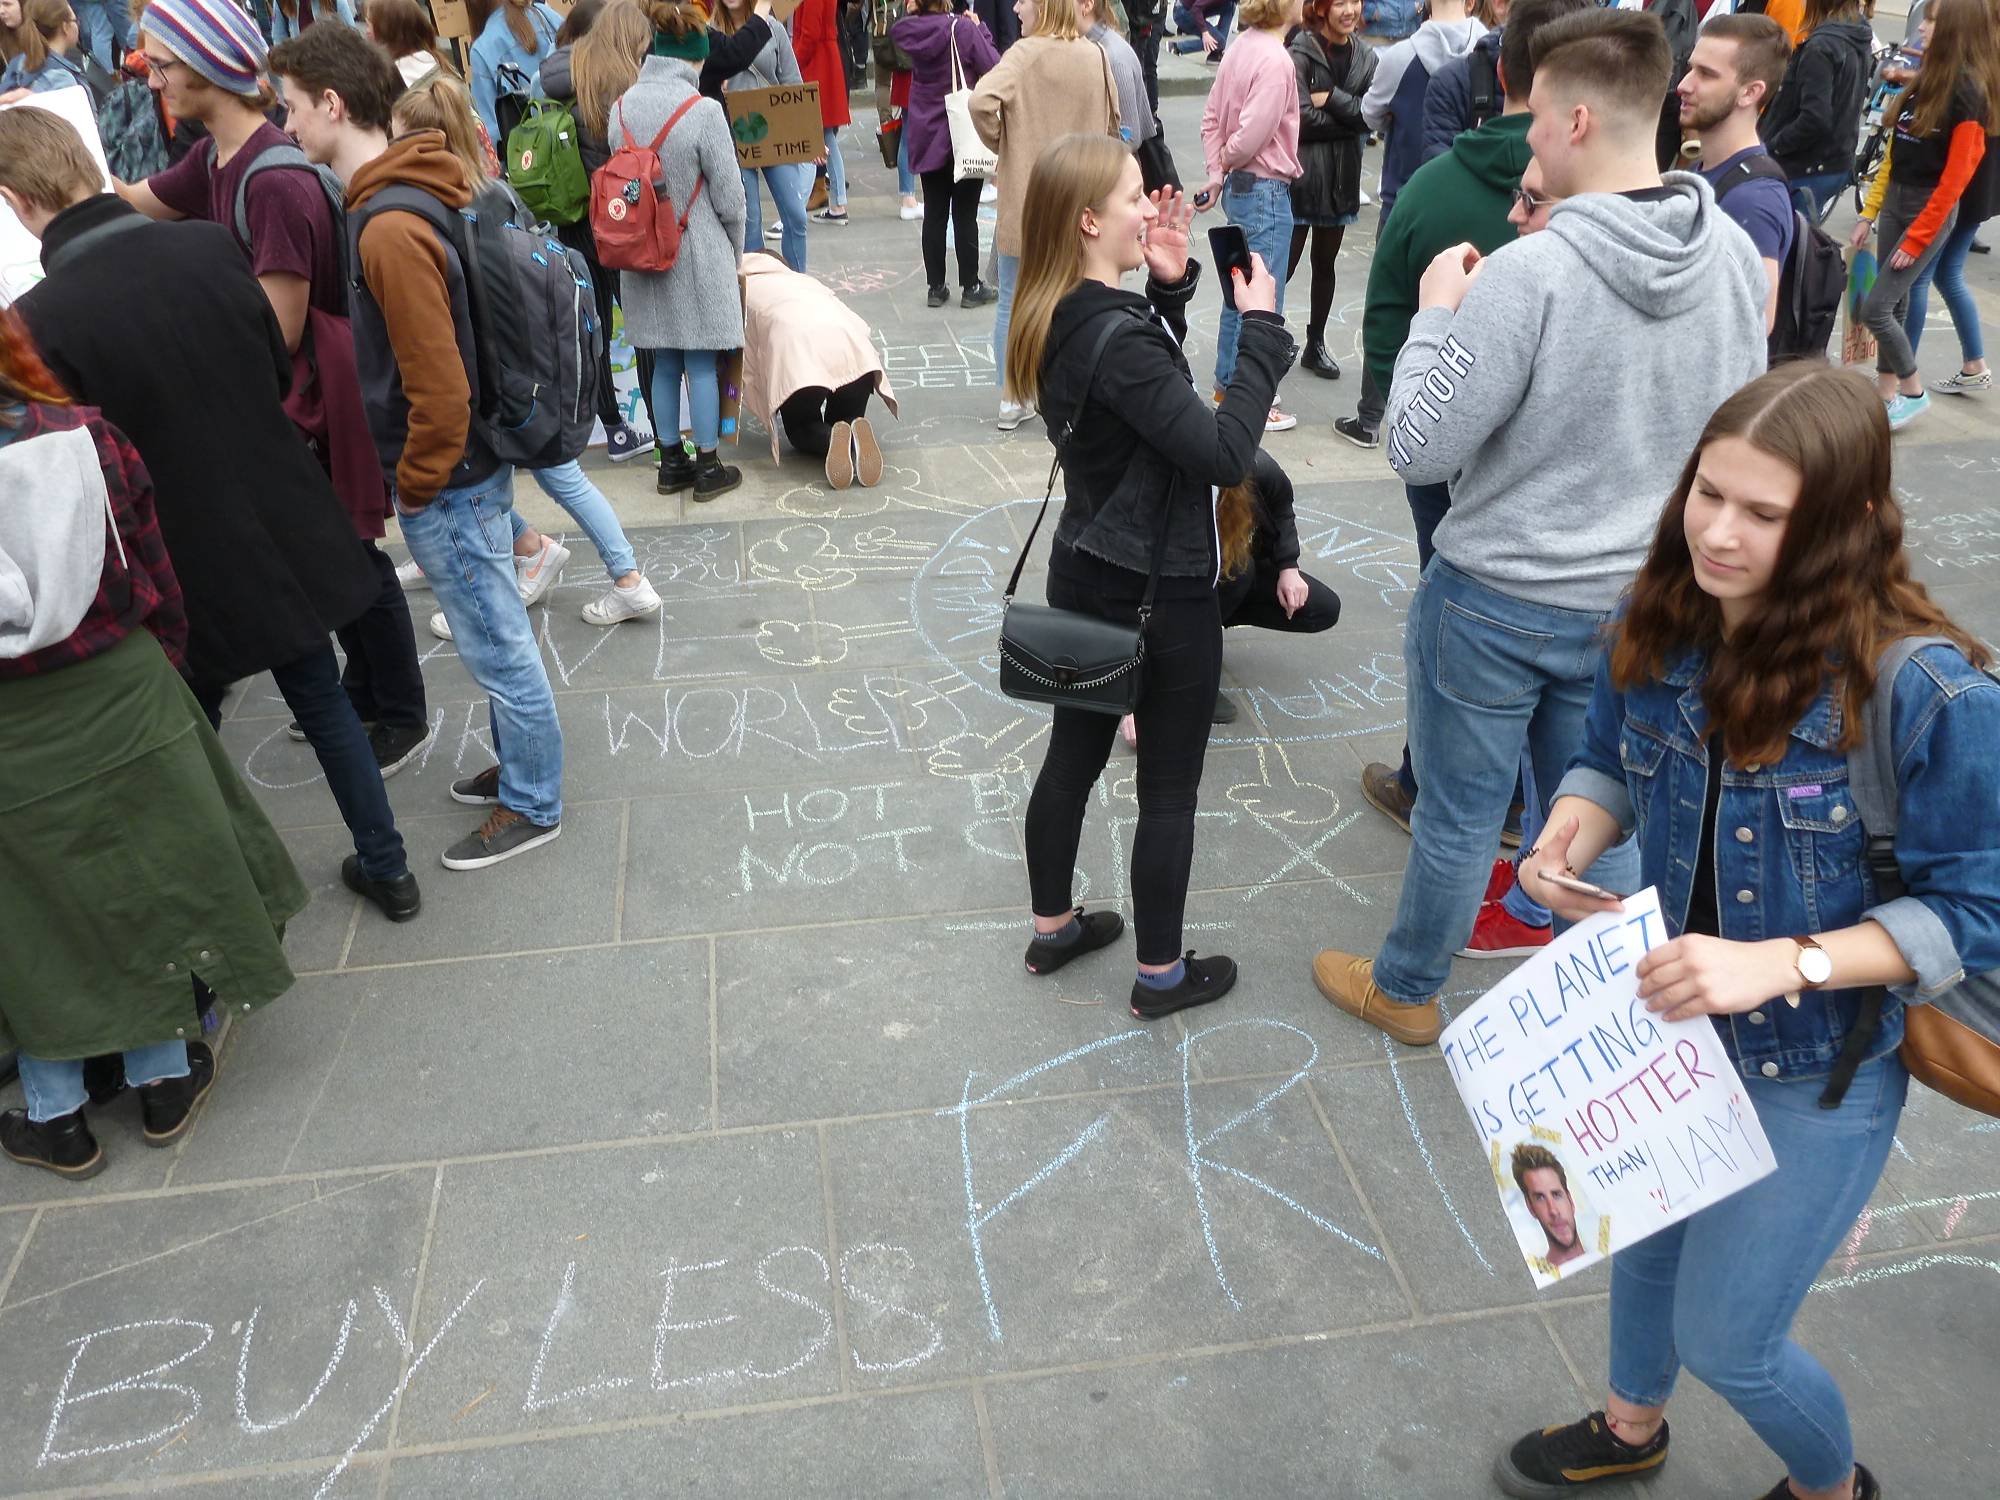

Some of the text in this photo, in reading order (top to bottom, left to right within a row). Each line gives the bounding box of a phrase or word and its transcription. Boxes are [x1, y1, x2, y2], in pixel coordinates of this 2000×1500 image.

[769, 87, 818, 107] DON'T
[773, 140, 811, 157] TIME
[744, 781, 903, 831] HOT
[738, 824, 932, 892] NOT
[1444, 909, 1656, 1081] THE PLANET
[1472, 998, 1663, 1141] IS GETTING
[1564, 1039, 1716, 1156] HOTTER
[935, 1018, 1495, 1343] FRI
[1587, 1143, 1648, 1190] THAN
[36, 1243, 945, 1500] BUY LESS
